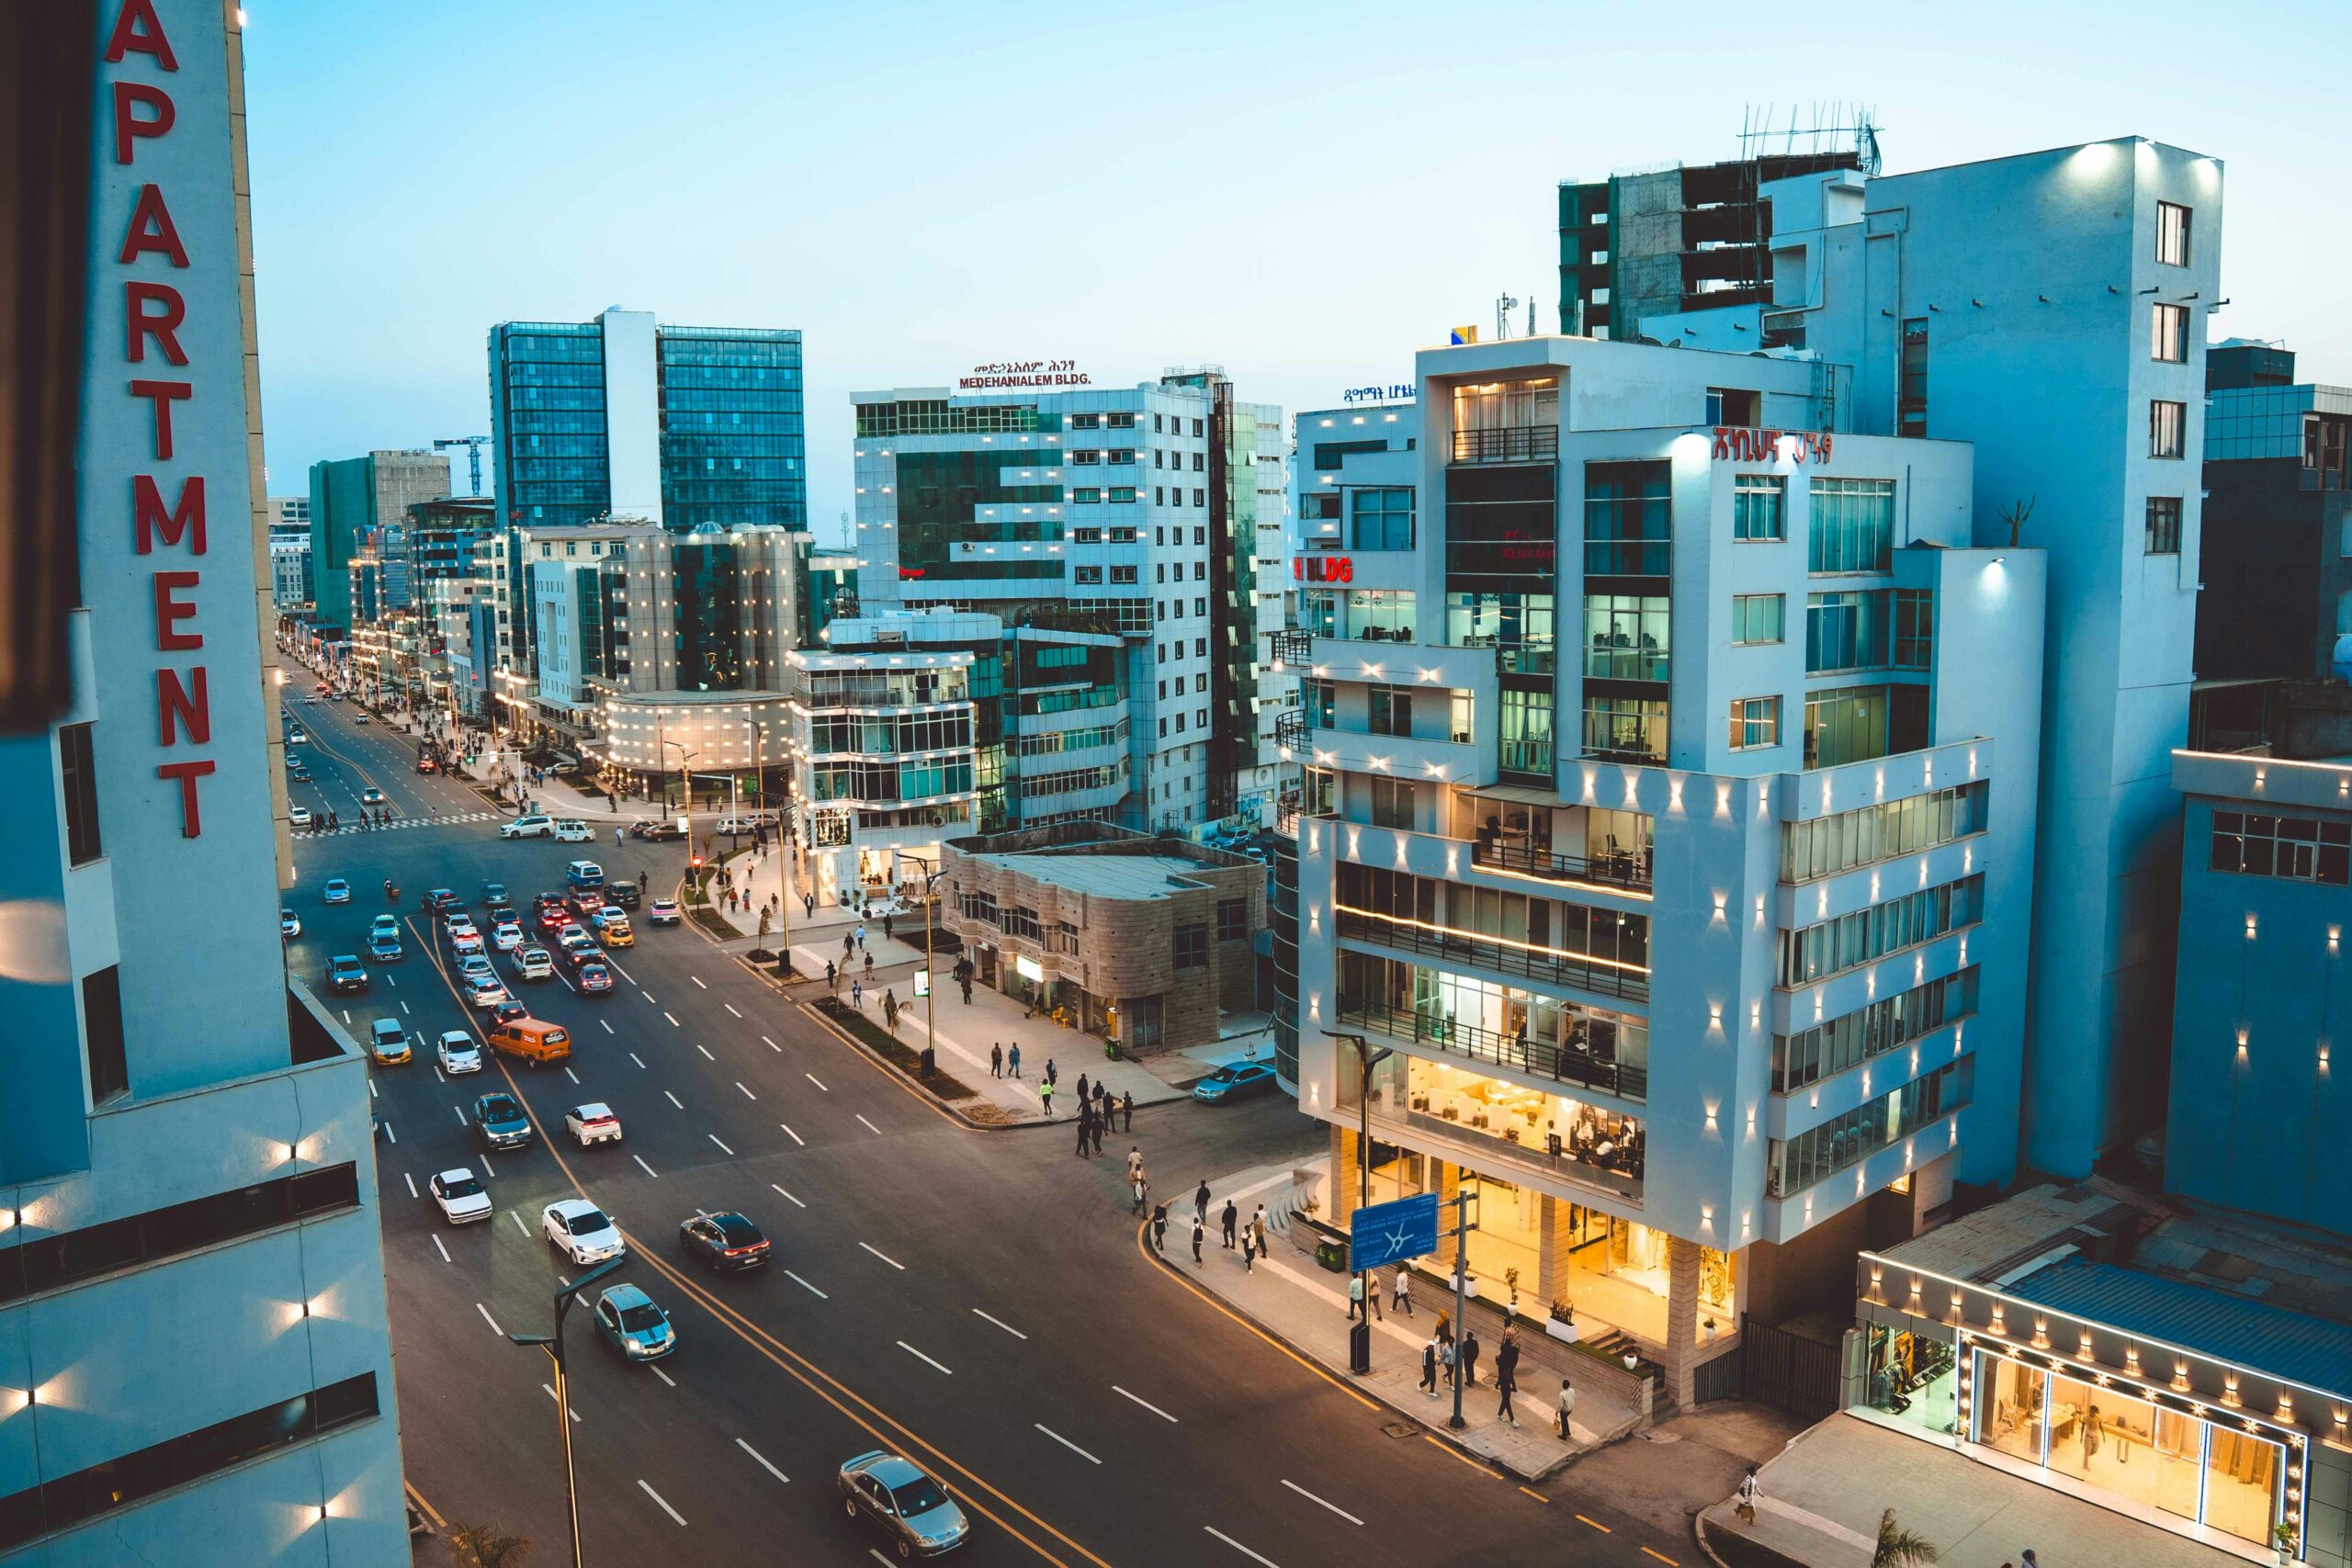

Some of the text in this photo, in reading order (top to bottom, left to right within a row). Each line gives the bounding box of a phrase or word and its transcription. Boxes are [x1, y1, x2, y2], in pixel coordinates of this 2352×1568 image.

[105, 0, 216, 839] APARTMENT
[959, 373, 1091, 389] MEDEHANIALEM BLDG.
